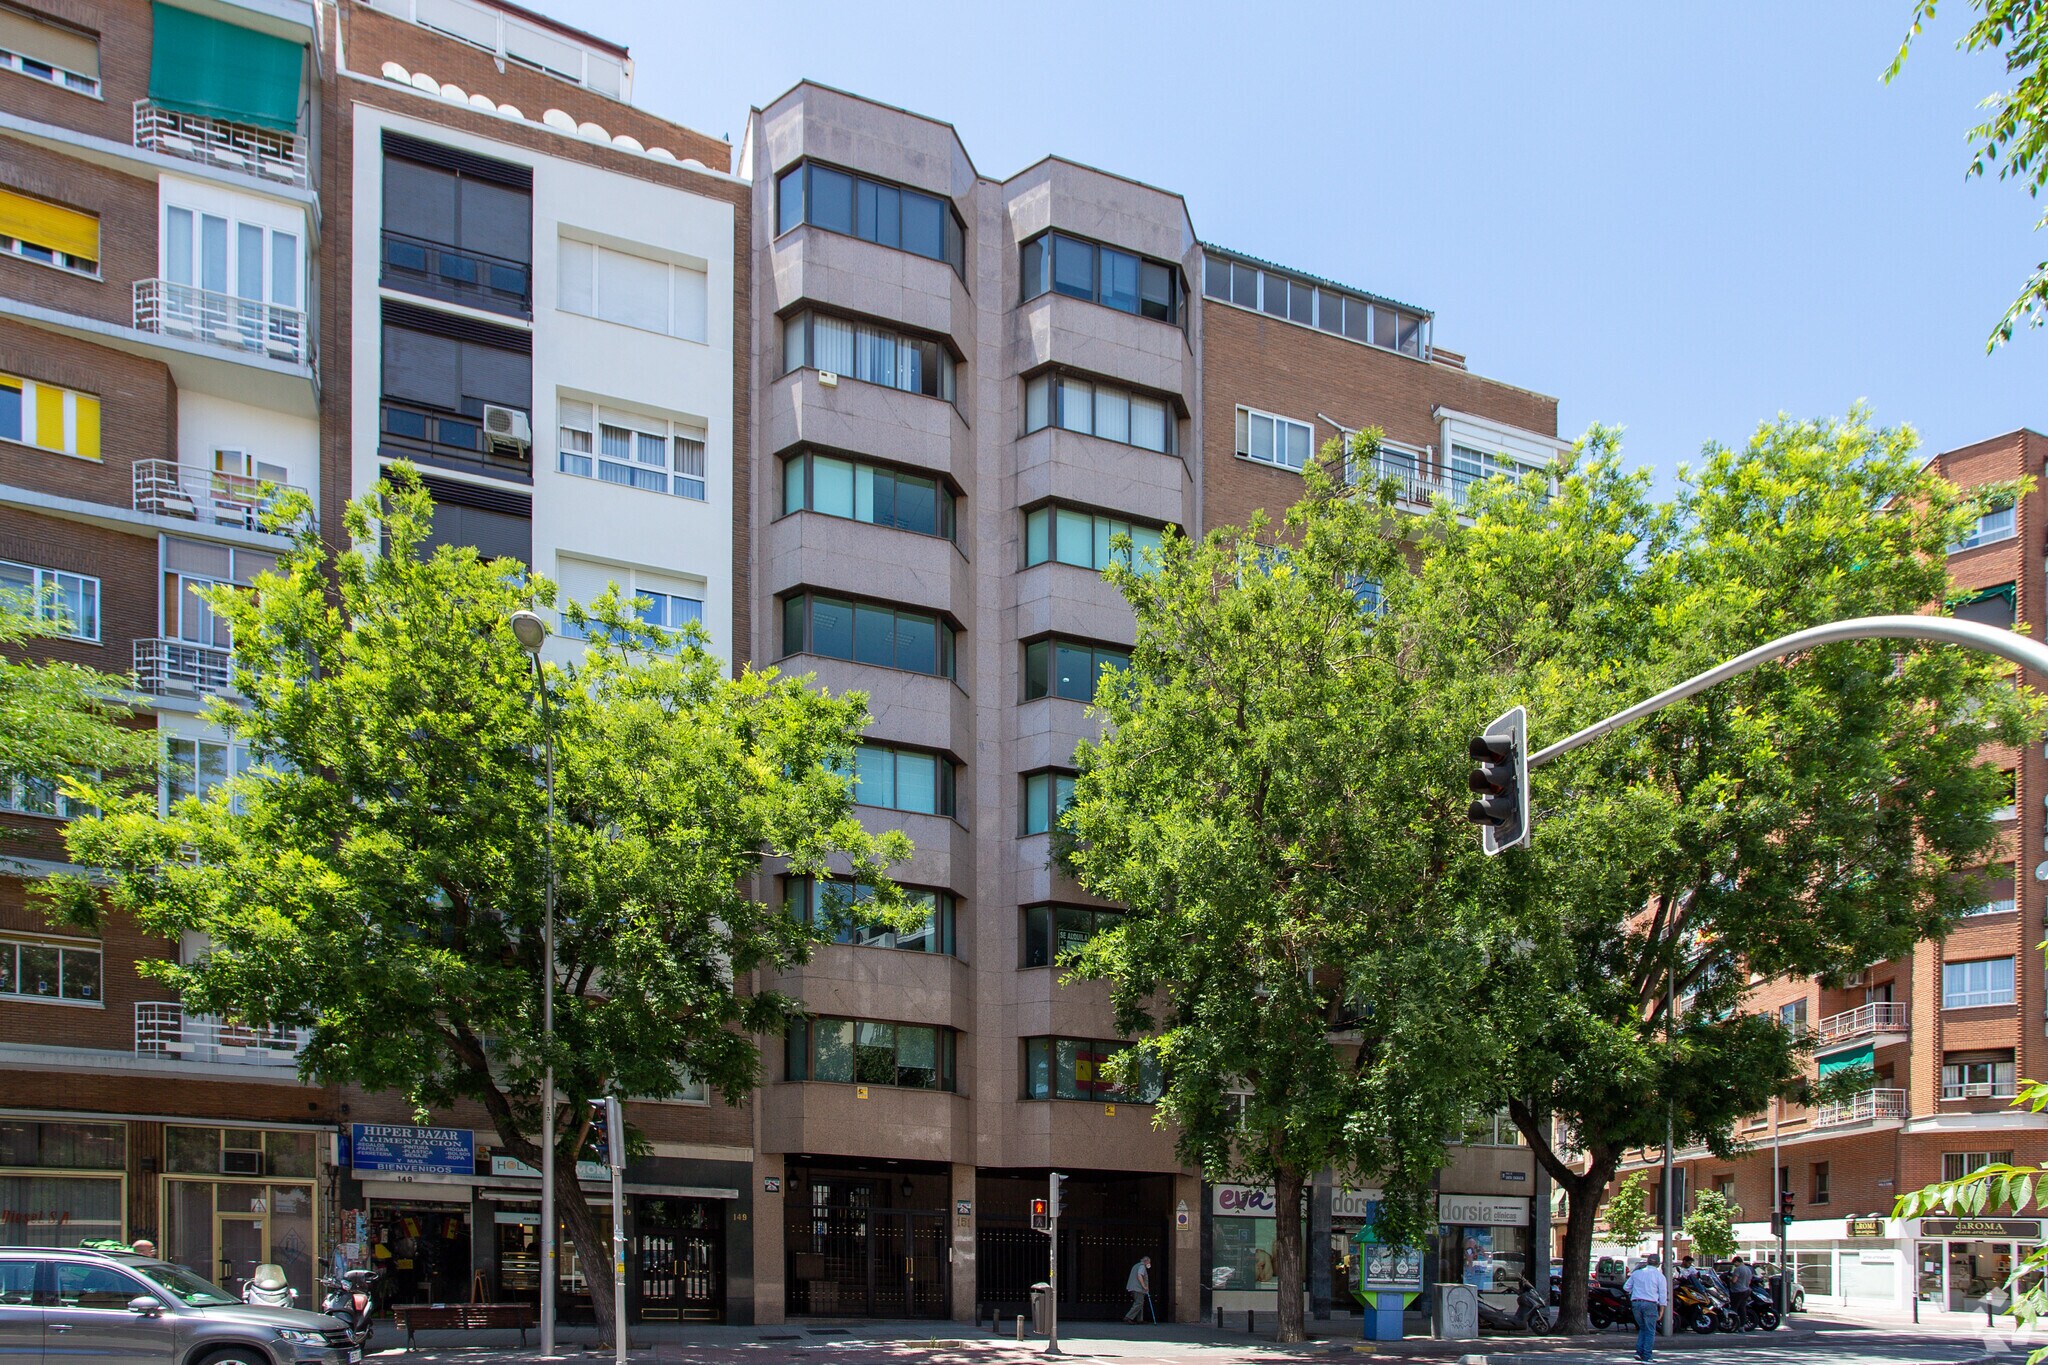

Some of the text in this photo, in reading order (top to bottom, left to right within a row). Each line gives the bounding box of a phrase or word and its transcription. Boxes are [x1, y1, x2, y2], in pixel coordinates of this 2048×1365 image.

[1067, 933, 1087, 941] ALQUILA
[363, 1126, 458, 1140] HIPER BAZAR
[360, 1136, 462, 1147] ALIMENTACION
[377, 1163, 452, 1173] BIENVENIDOS
[398, 1175, 413, 1183] 149
[1219, 1189, 1273, 1211] eva
[1441, 1198, 1491, 1222] dorsia
[733, 1213, 748, 1221] 149
[957, 1217, 970, 1227] 151
[1955, 1221, 2003, 1230] daROMA
